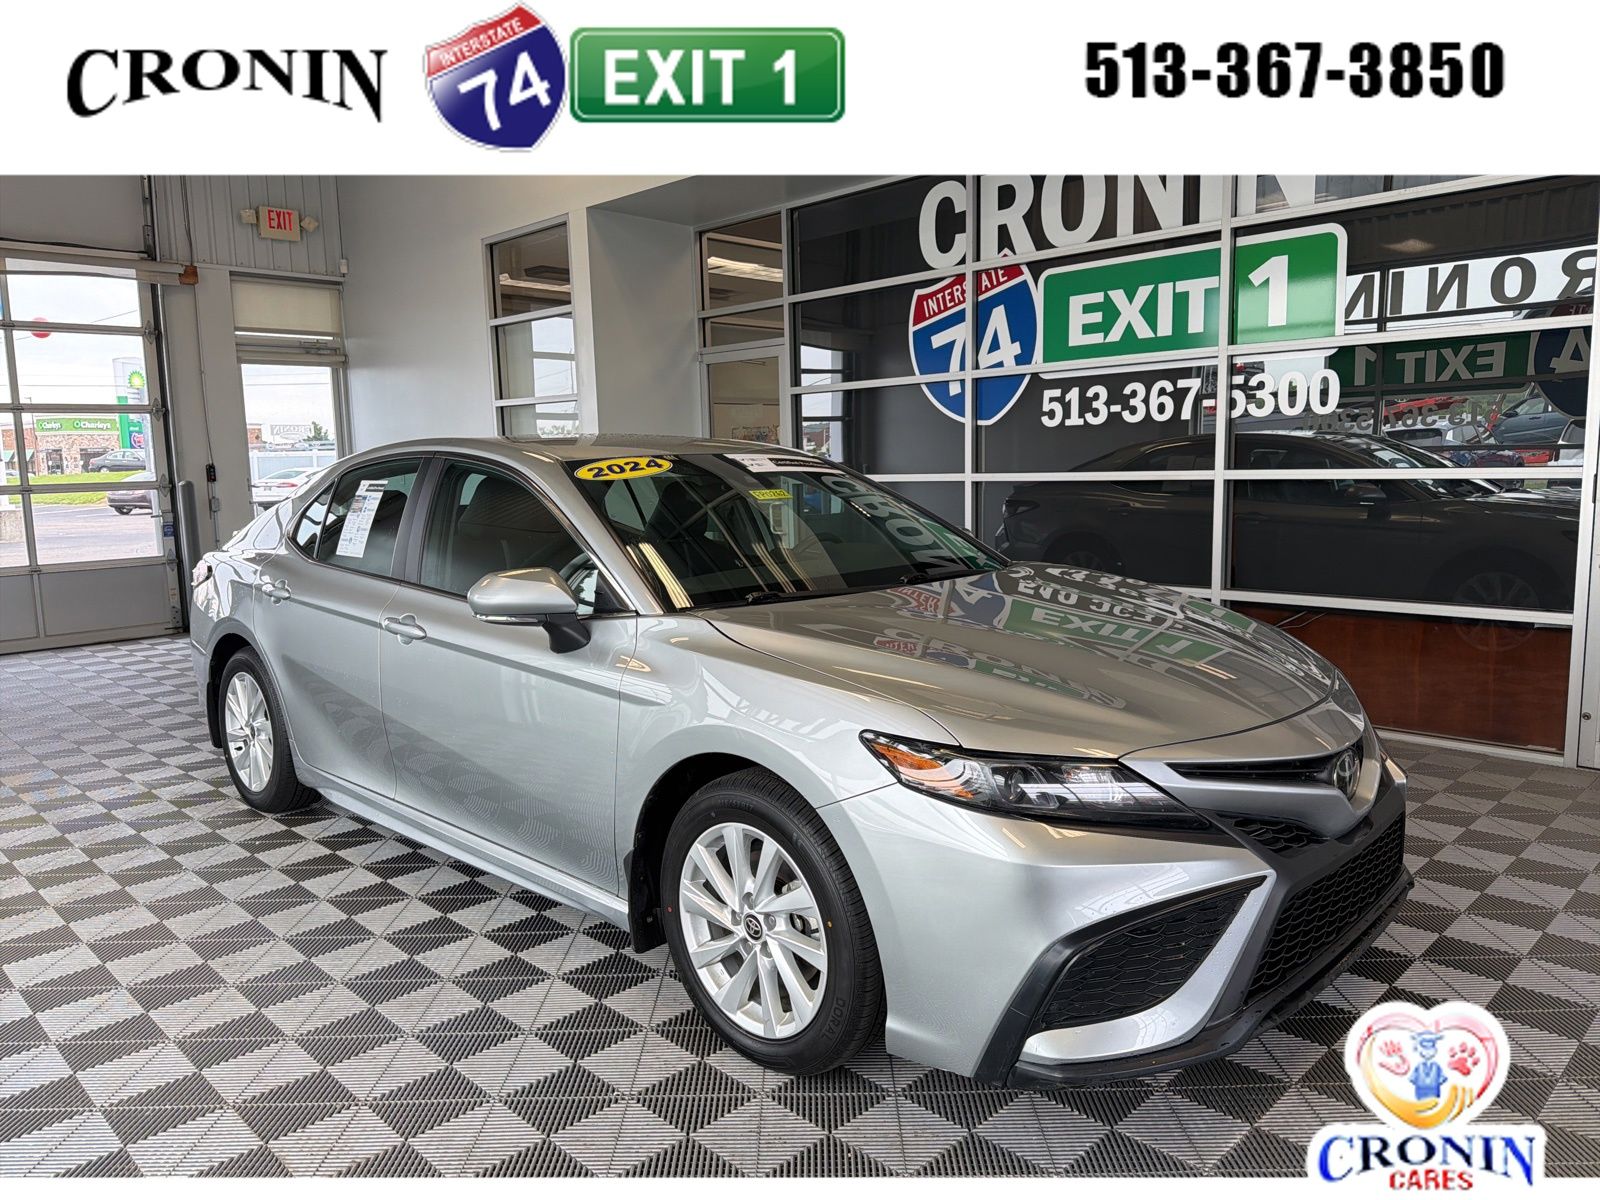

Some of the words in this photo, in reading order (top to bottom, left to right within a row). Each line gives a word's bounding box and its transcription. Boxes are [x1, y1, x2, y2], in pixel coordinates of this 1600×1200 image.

[267, 208, 293, 231] EXIT
[922, 267, 1009, 318] INTERSATE
[1069, 276, 1219, 347] EXIT
[1247, 254, 1289, 327] 1
[930, 304, 1022, 397] 74
[1040, 368, 1341, 428] 513-367-5300
[587, 459, 664, 478] 2024
